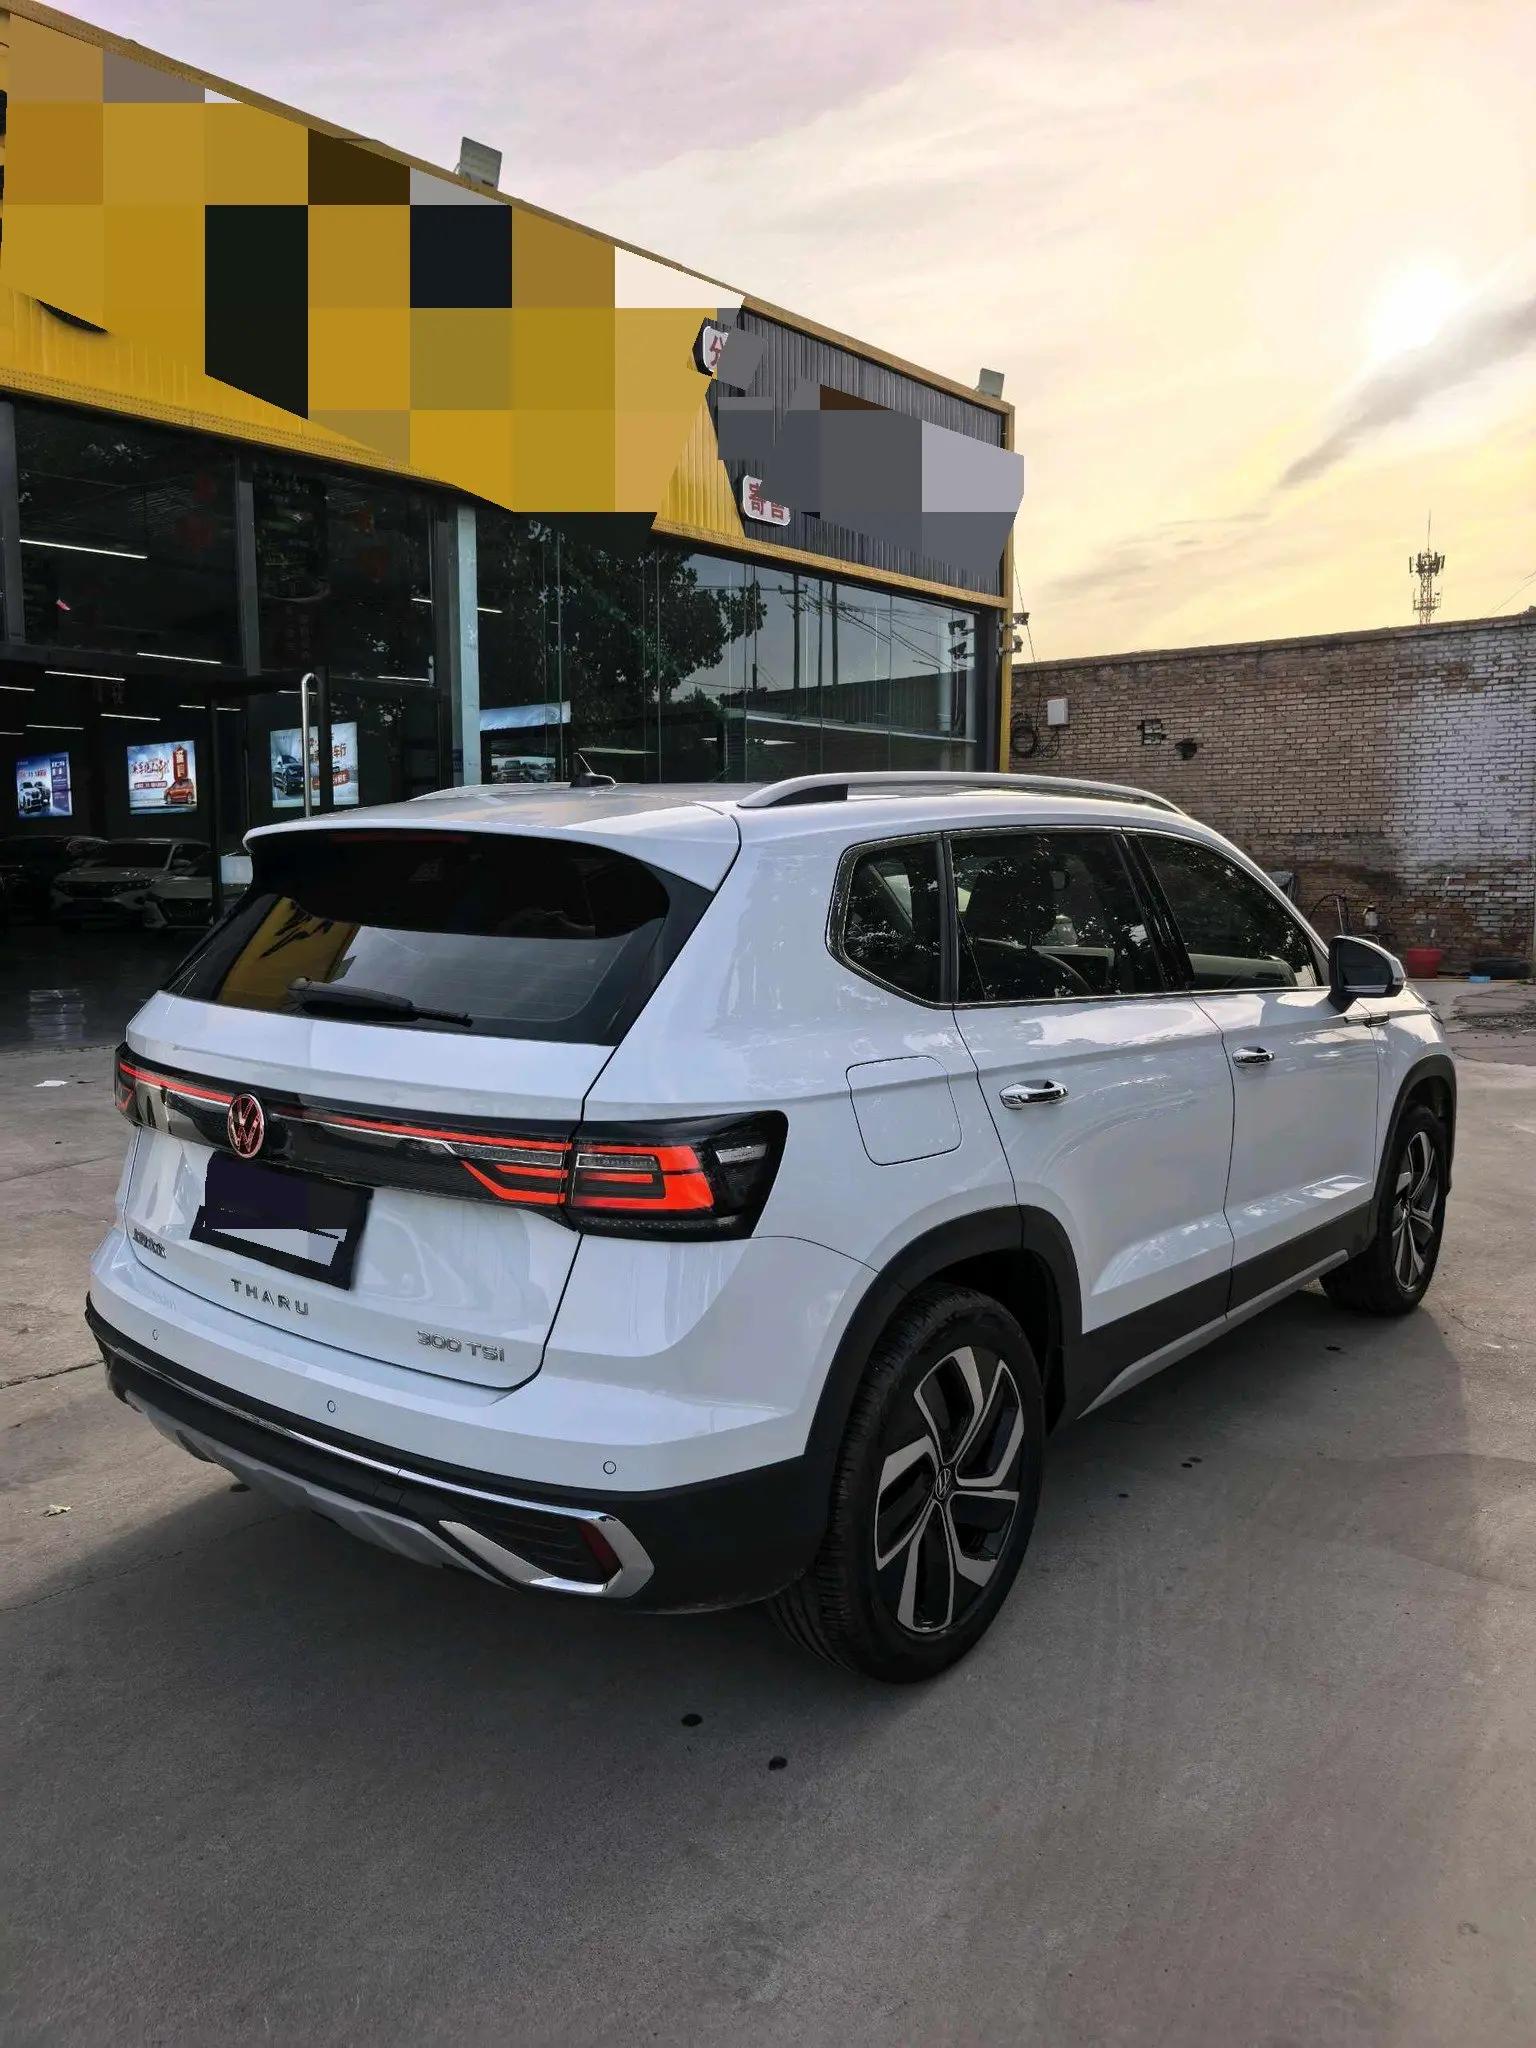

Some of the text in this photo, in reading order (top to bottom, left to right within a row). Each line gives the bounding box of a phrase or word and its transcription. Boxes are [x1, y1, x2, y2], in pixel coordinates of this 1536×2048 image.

[230, 1278, 309, 1316] THARU
[417, 1330, 505, 1363] 300 TSI
